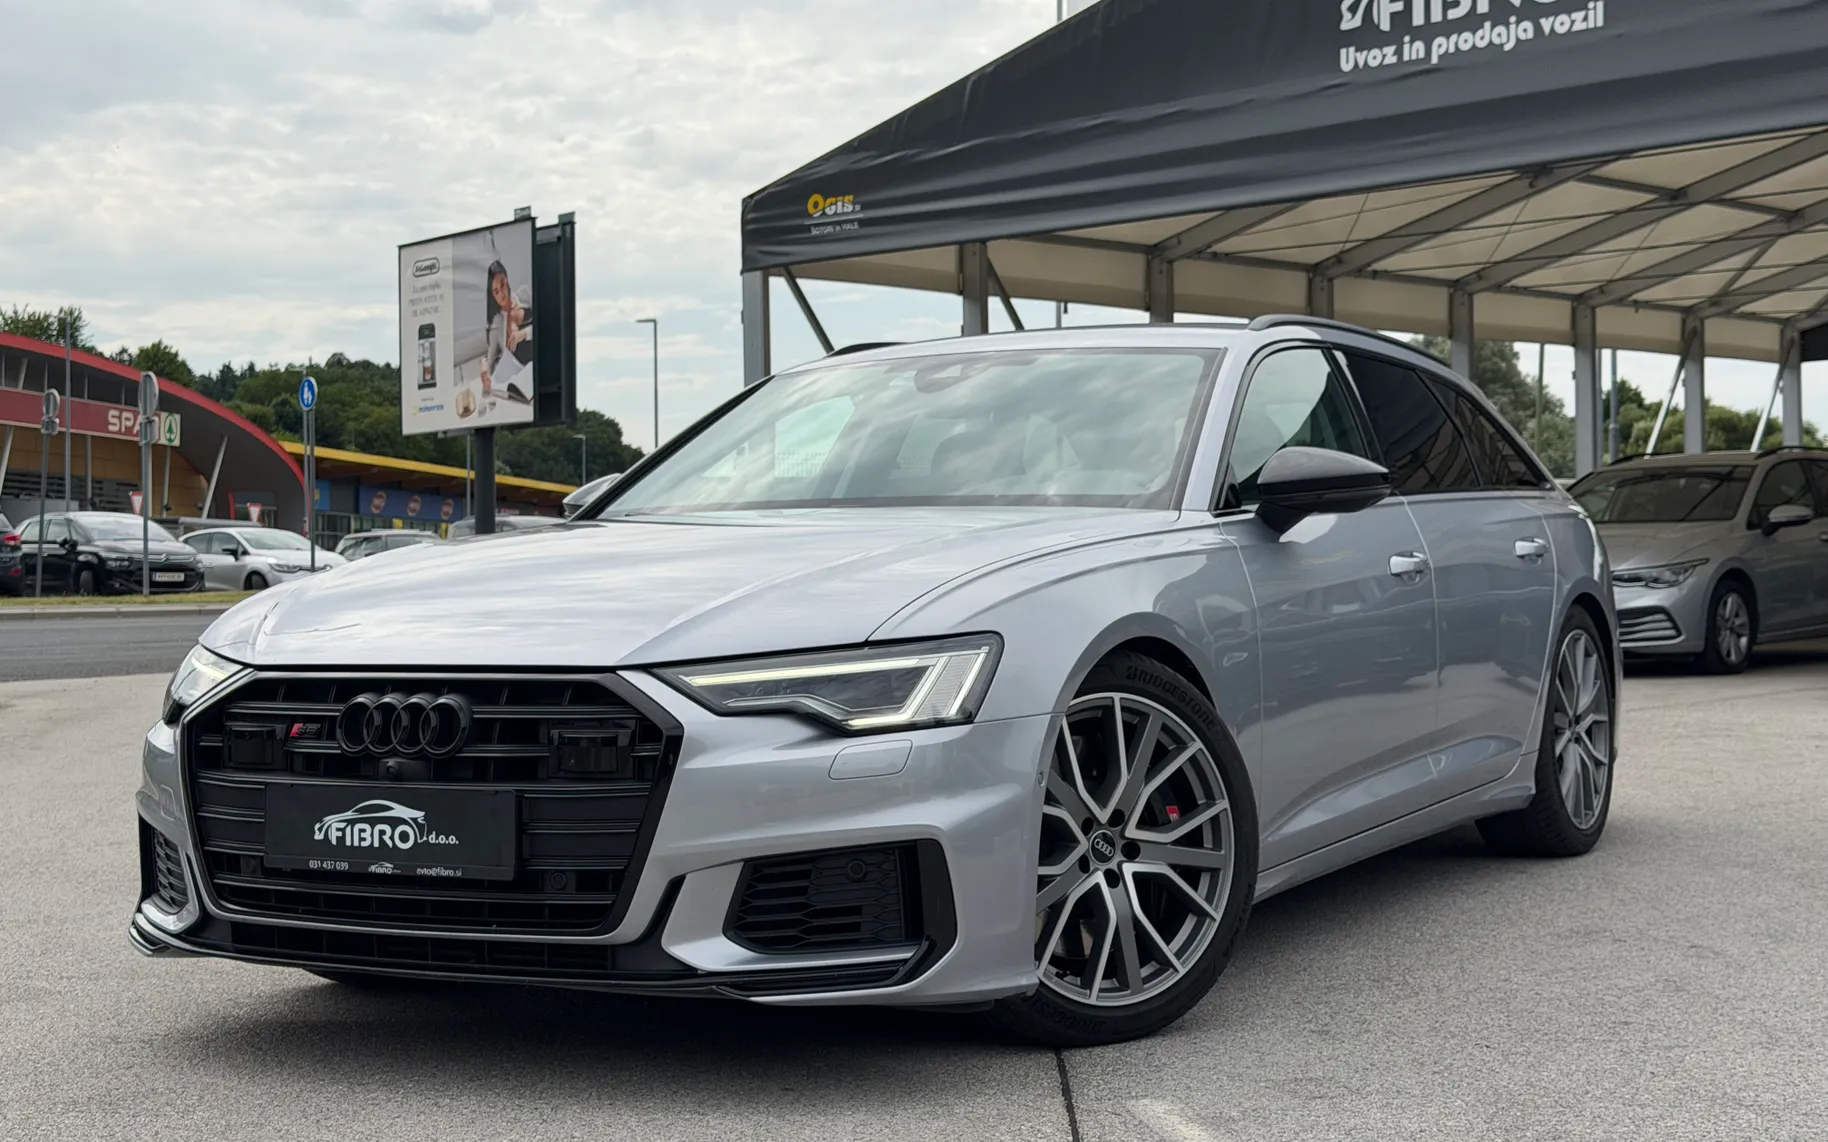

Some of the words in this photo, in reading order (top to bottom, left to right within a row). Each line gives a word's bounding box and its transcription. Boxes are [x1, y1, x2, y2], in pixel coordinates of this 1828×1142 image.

[1339, 45, 1398, 72] Uvoz
[1402, 35, 1425, 62] in
[1430, 15, 1534, 64] prodaja
[1538, 0, 1604, 37] vozil
[108, 409, 159, 435] SP
[1125, 665, 1216, 731] BRIDGESTONE
[329, 822, 415, 849] FIBRO
[428, 831, 459, 845] d.o.o.
[309, 860, 321, 869] 031
[322, 861, 335, 870] 437
[335, 861, 349, 871] 039
